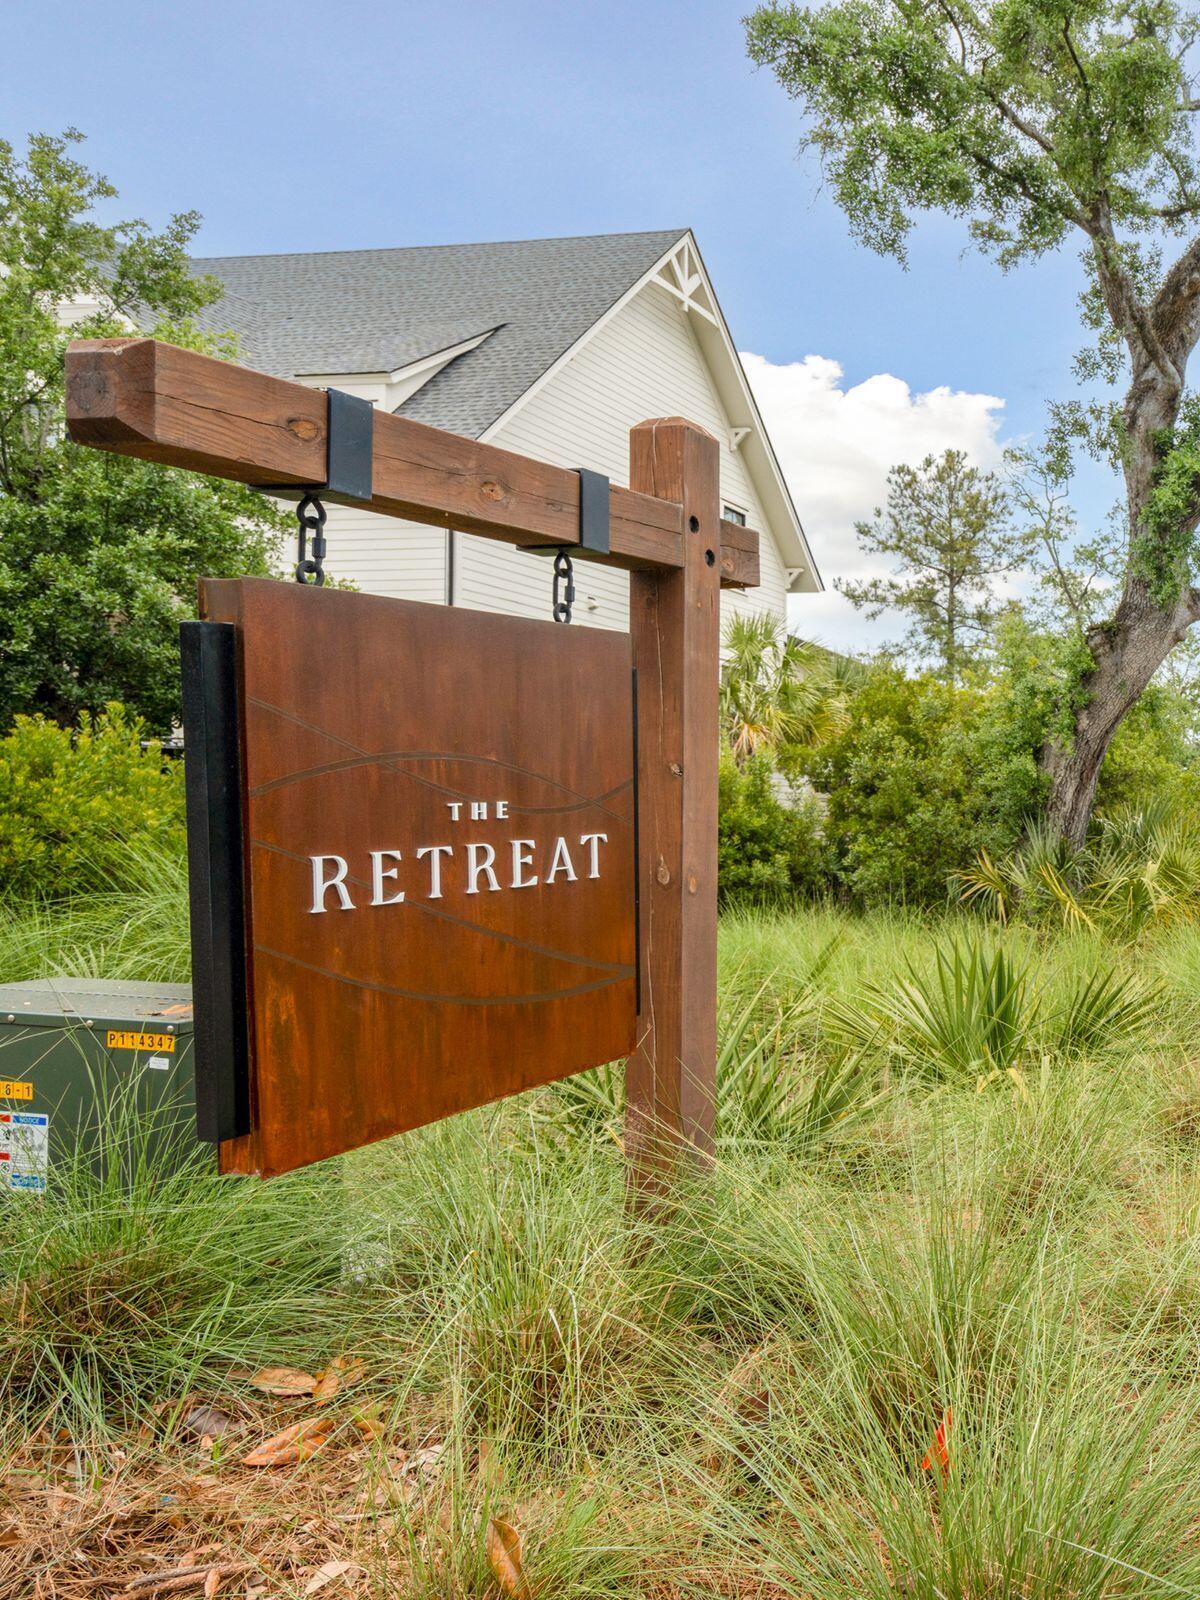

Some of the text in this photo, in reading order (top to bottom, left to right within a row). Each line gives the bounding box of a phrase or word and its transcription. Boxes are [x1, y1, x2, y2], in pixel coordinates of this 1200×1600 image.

[447, 801, 509, 821] THE
[309, 833, 608, 913] RETREAT
[109, 1033, 173, 1049] P114347
